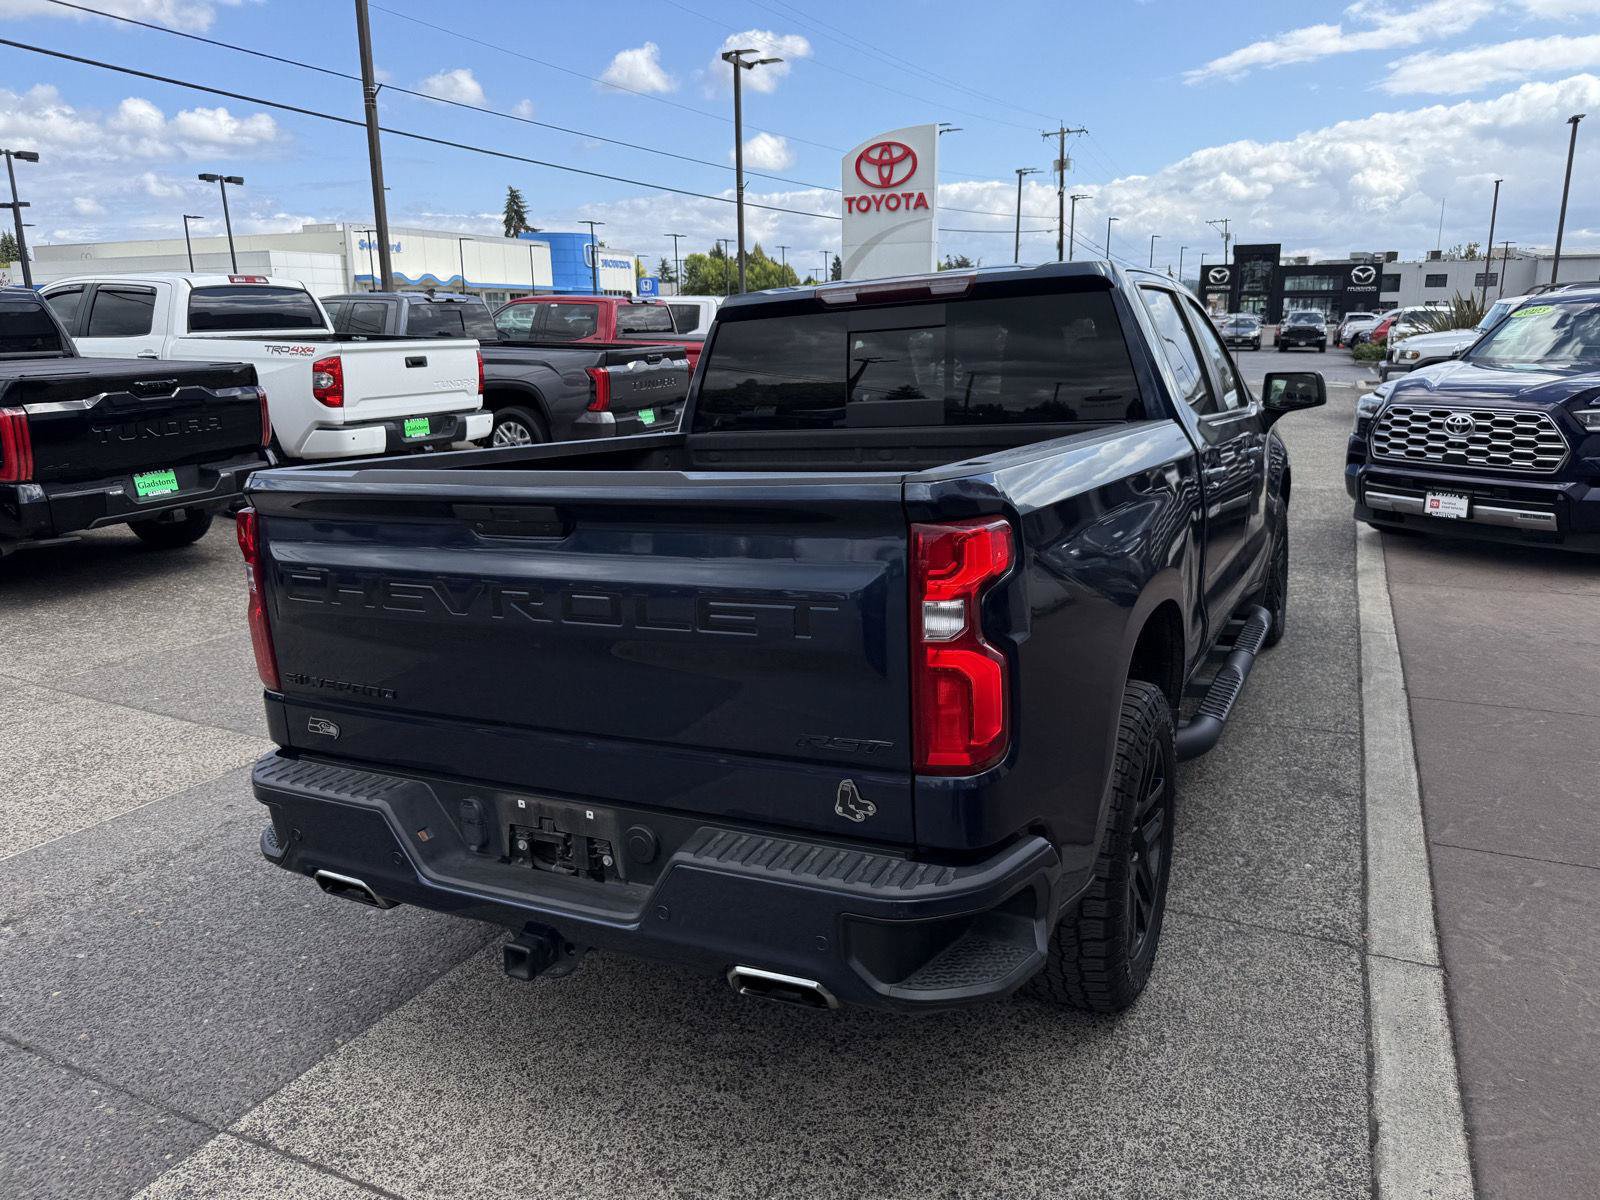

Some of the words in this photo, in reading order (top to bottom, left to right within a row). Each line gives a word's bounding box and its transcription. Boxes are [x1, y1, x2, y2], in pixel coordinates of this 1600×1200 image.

[843, 191, 930, 214] TOYOTA
[91, 416, 223, 443] TUNDRA
[137, 478, 176, 490] Gladstone
[286, 565, 842, 640] CHEVROLET
[796, 734, 895, 754] RST
